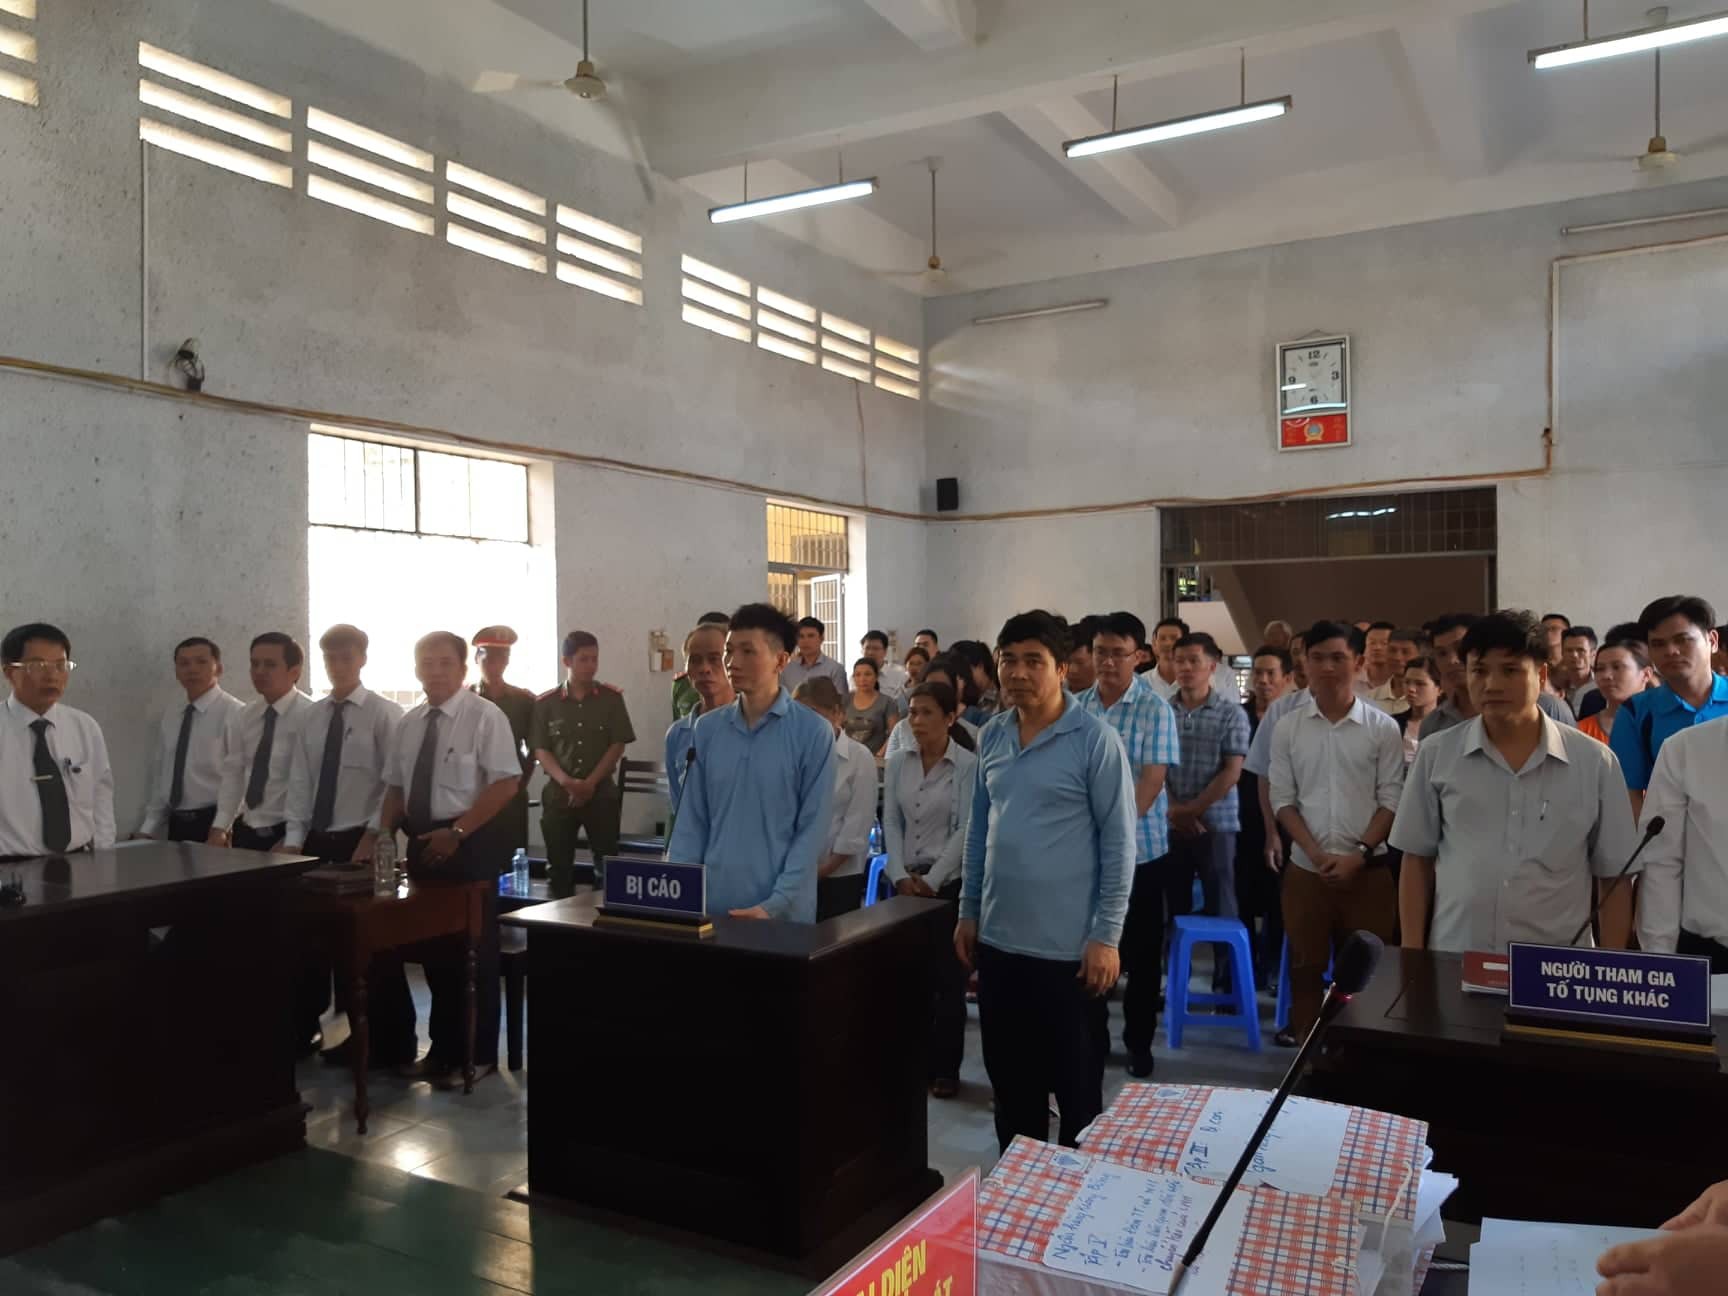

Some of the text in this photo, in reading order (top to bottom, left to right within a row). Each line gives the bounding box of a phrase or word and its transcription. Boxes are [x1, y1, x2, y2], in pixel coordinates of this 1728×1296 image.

[1308, 350, 1320, 360] 12
[1331, 371, 1339, 381] 3
[626, 873, 681, 900] BỊ CÁO
[1541, 960, 1676, 987] NGƯỜI THAM GIA
[1546, 979, 1670, 1008] TỐ TỤNG KHÁC
